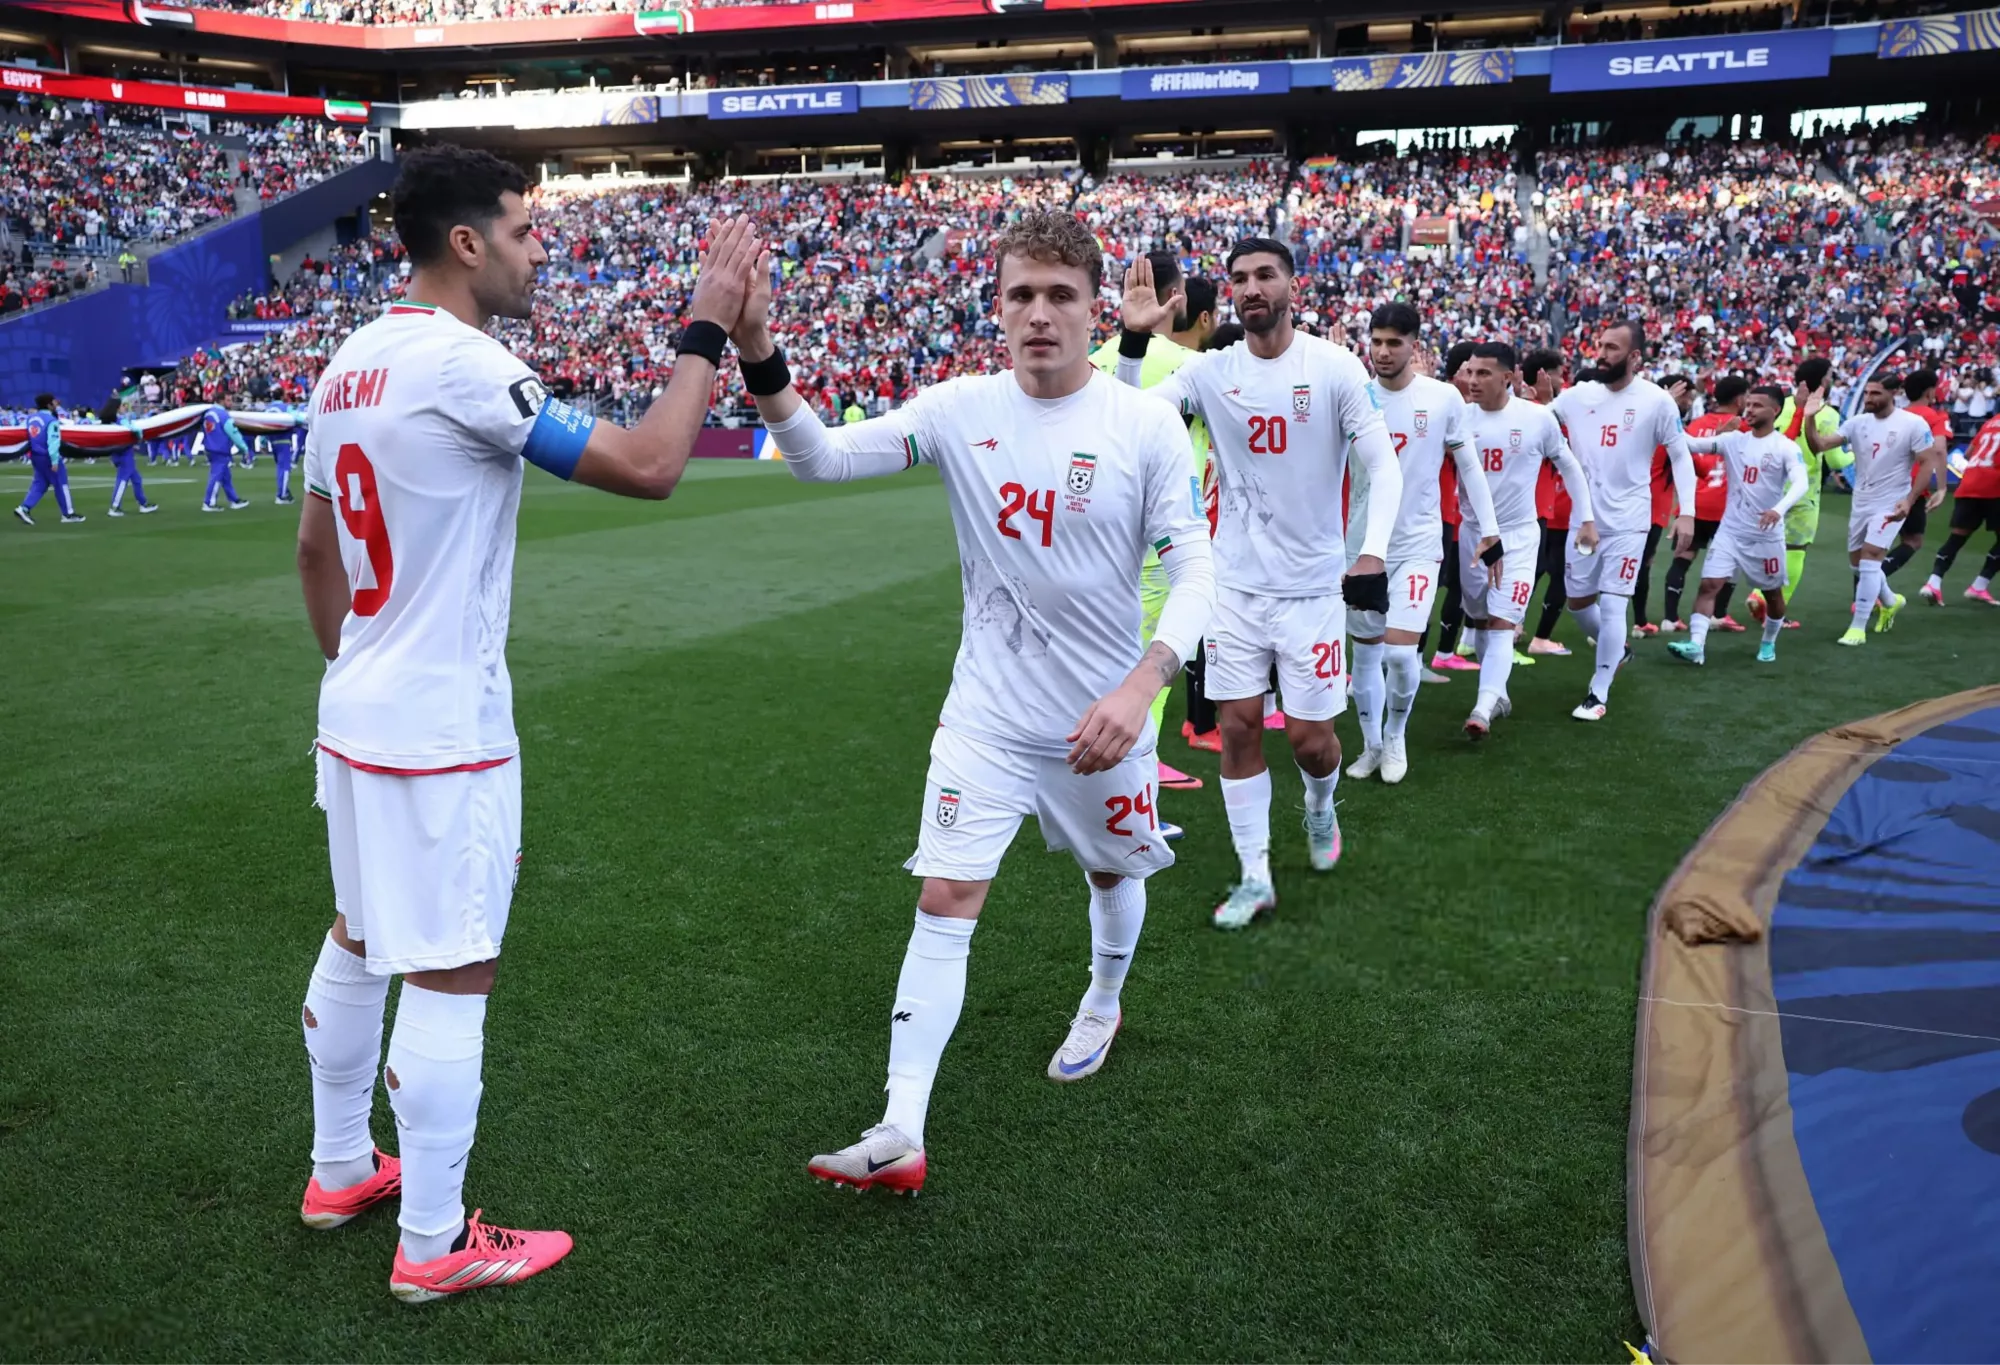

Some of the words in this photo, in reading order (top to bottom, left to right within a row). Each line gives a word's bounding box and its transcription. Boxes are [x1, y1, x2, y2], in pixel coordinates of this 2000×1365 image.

[1608, 48, 1769, 76] SEATTLE
[3, 70, 42, 89] EGYPT
[111, 83, 123, 98] V
[1151, 70, 1260, 92] #FIFAWorldCup
[722, 92, 842, 113] SEATTLE
[319, 367, 389, 415] TAREMI
[1248, 416, 1286, 454] 20
[1389, 433, 1408, 458] 7
[1601, 425, 1617, 447] 15
[1482, 448, 1503, 472] 18
[1872, 443, 1880, 459] 7
[1743, 465, 1758, 484] 10
[997, 482, 1056, 547] 24
[335, 443, 395, 617] 9
[1619, 557, 1637, 579] 15
[1763, 557, 1779, 575] 10
[1407, 574, 1429, 601] 17
[1511, 581, 1530, 606] 18
[1312, 639, 1340, 679] 20
[1105, 782, 1155, 837] 24
